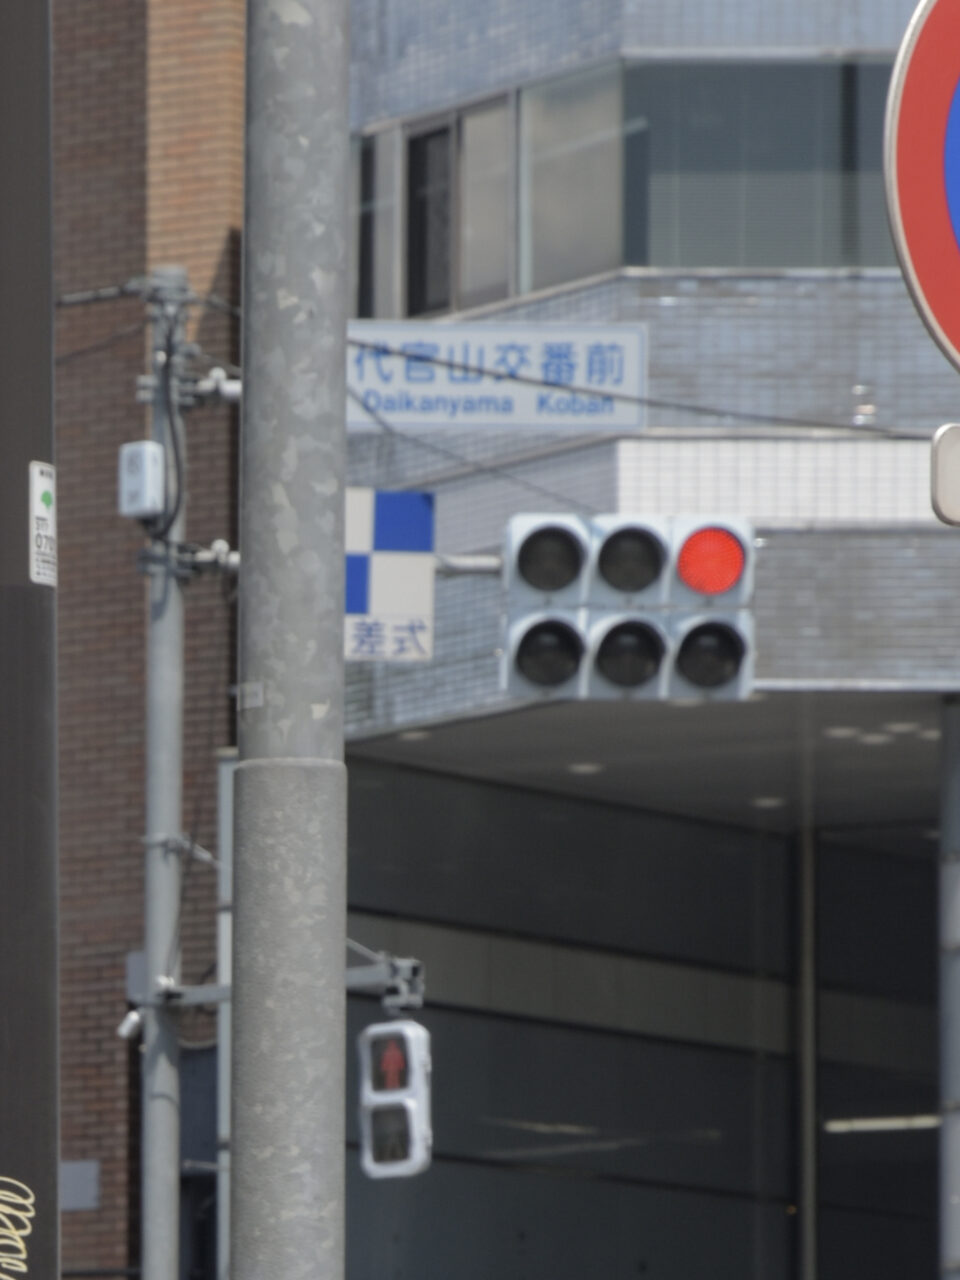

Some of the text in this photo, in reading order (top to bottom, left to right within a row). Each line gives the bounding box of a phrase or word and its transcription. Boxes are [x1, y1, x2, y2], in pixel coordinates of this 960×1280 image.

[353, 341, 626, 386] 代官山交番前
[363, 390, 615, 416] Daikanyama Koban
